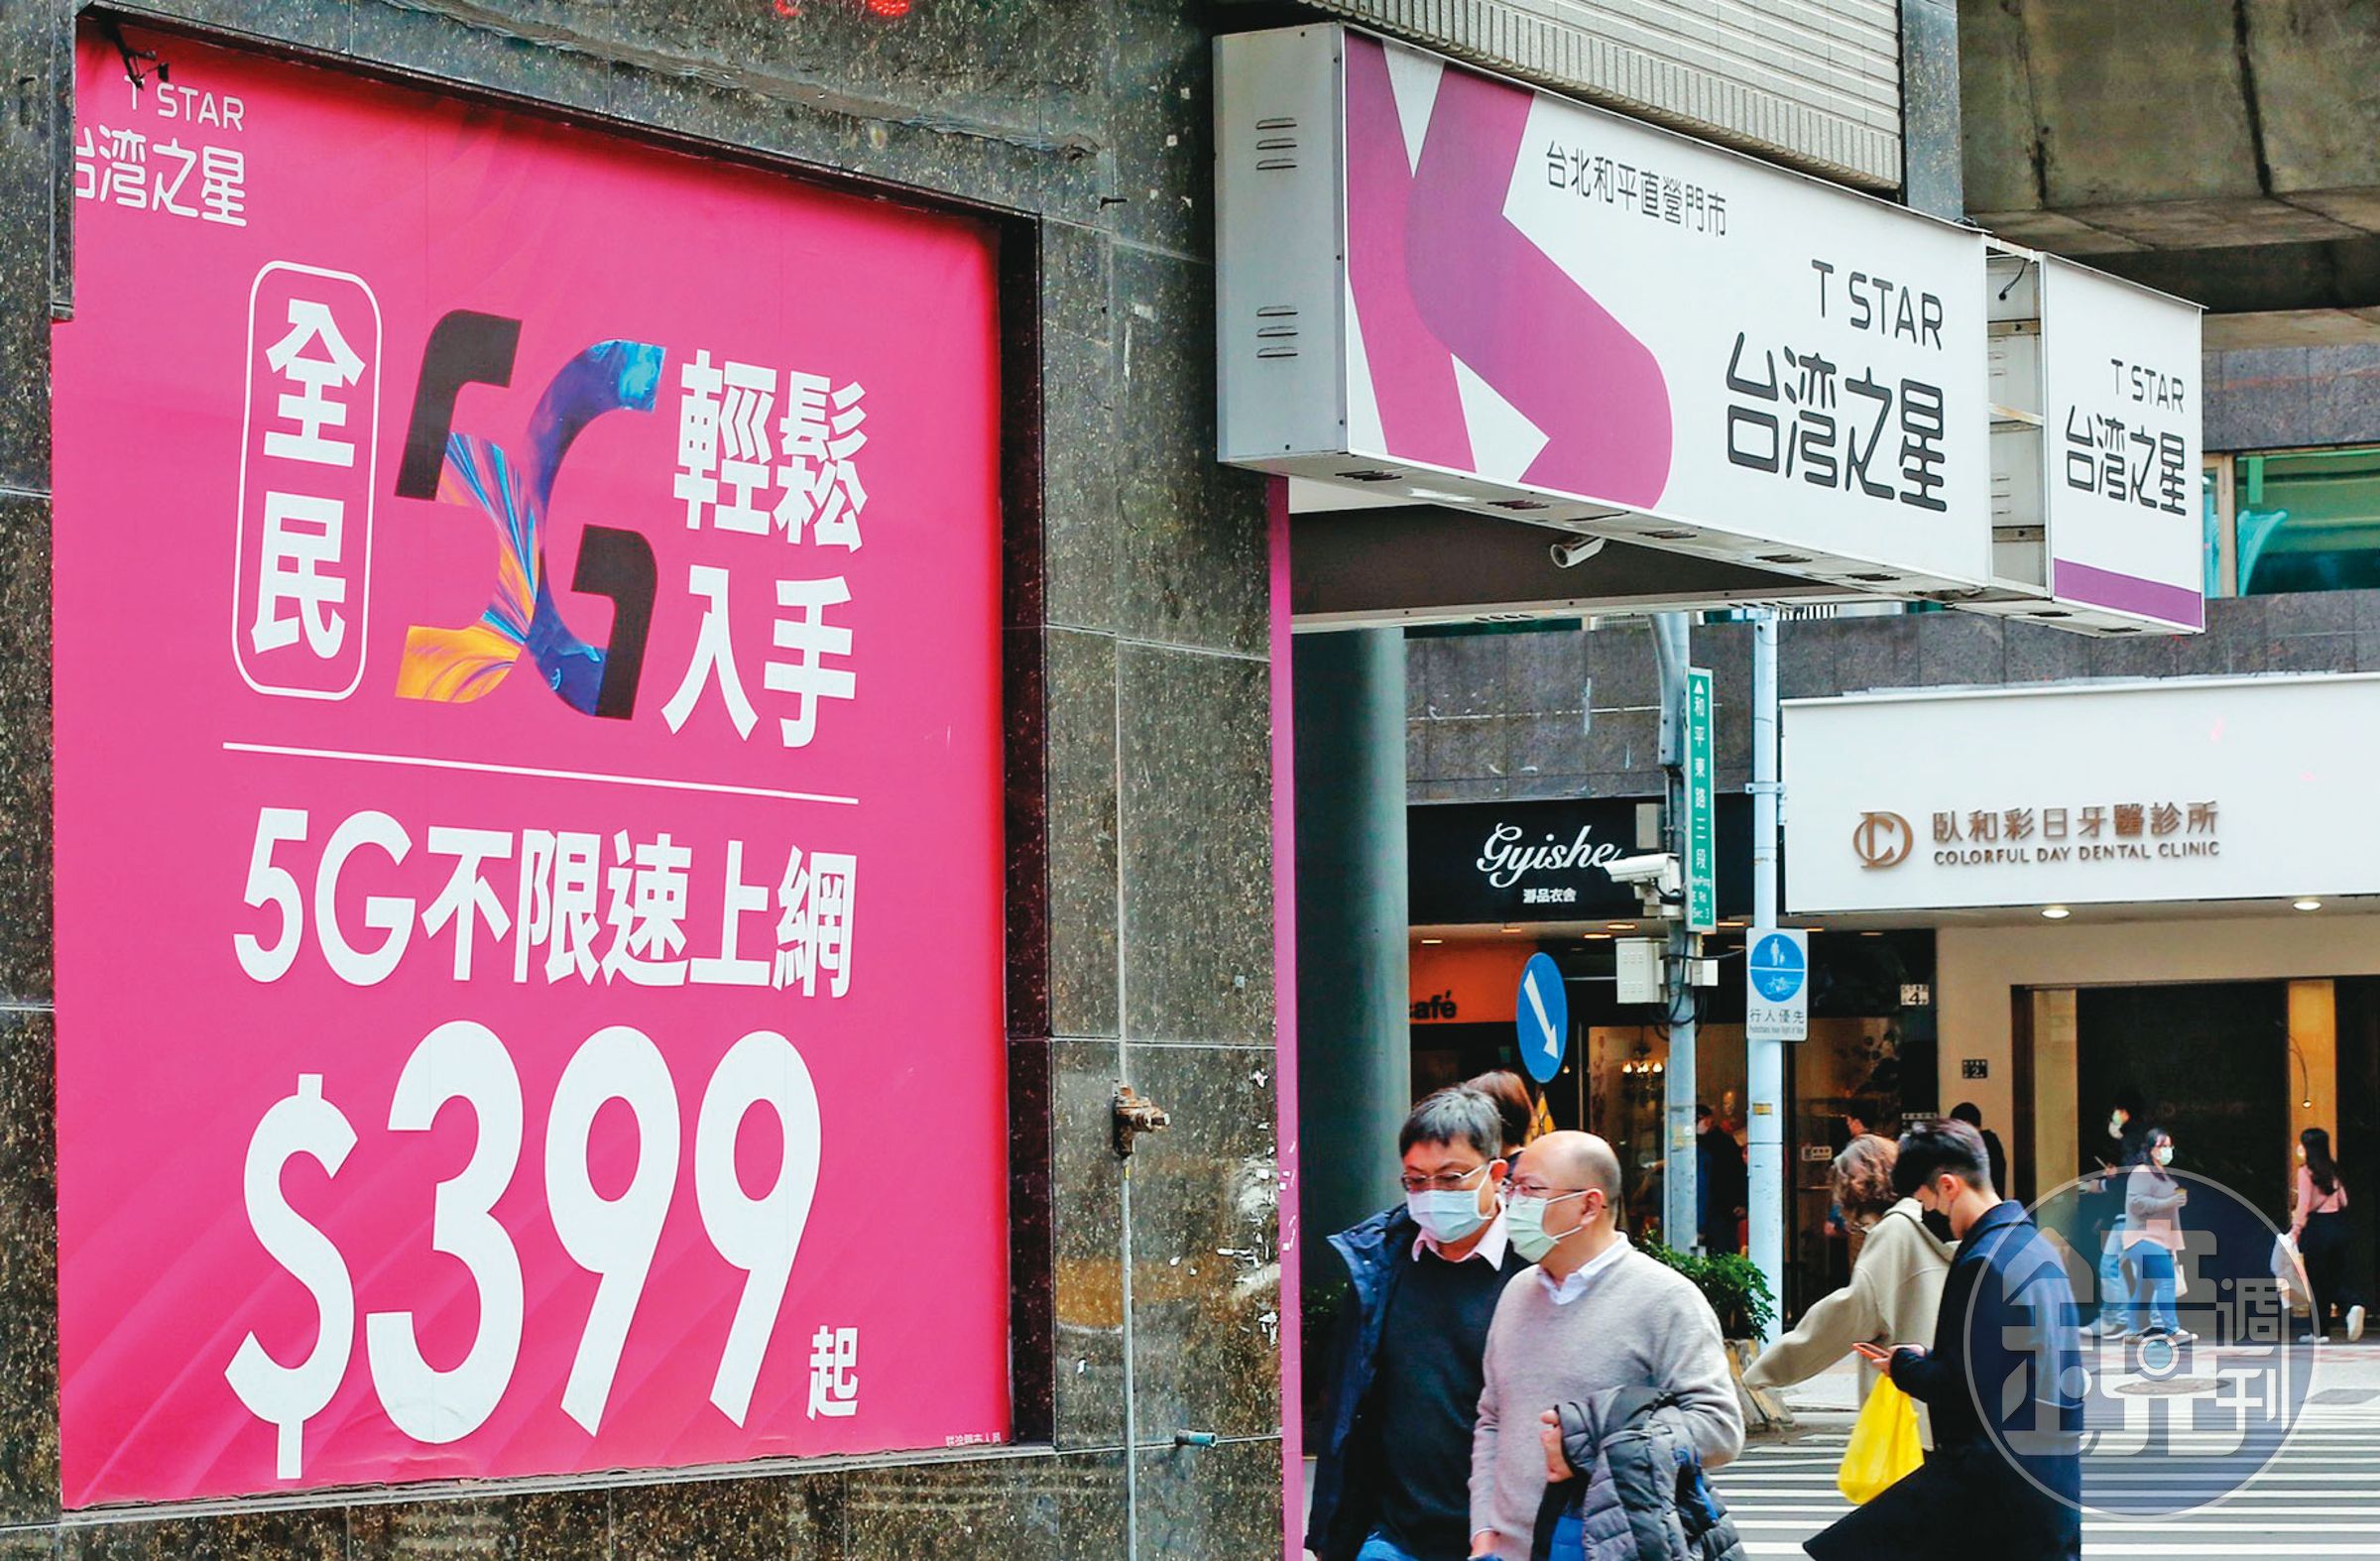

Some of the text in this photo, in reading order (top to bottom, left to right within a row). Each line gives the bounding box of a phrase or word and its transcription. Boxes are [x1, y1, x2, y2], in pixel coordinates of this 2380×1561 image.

[124, 75, 245, 131] T STAR
[1546, 140, 1726, 237] 台北和平直營門市
[1812, 259, 1944, 350] T STAR
[1726, 331, 1948, 512] 台湾之星
[2110, 358, 2186, 413] T STAR
[251, 299, 366, 660] 全民
[673, 348, 869, 552] 輕鬆
[2066, 405, 2187, 517] 台湾之星
[395, 308, 666, 721] 5G
[660, 564, 857, 748] 入手
[1476, 822, 1623, 889] Gyishe
[1934, 841, 2220, 866] COLORFUL DAY DENTAL CLINIC
[232, 806, 858, 1000] 5G不限速上網
[1409, 990, 1457, 1020] afé
[1749, 1009, 1805, 1023] 行人優先
